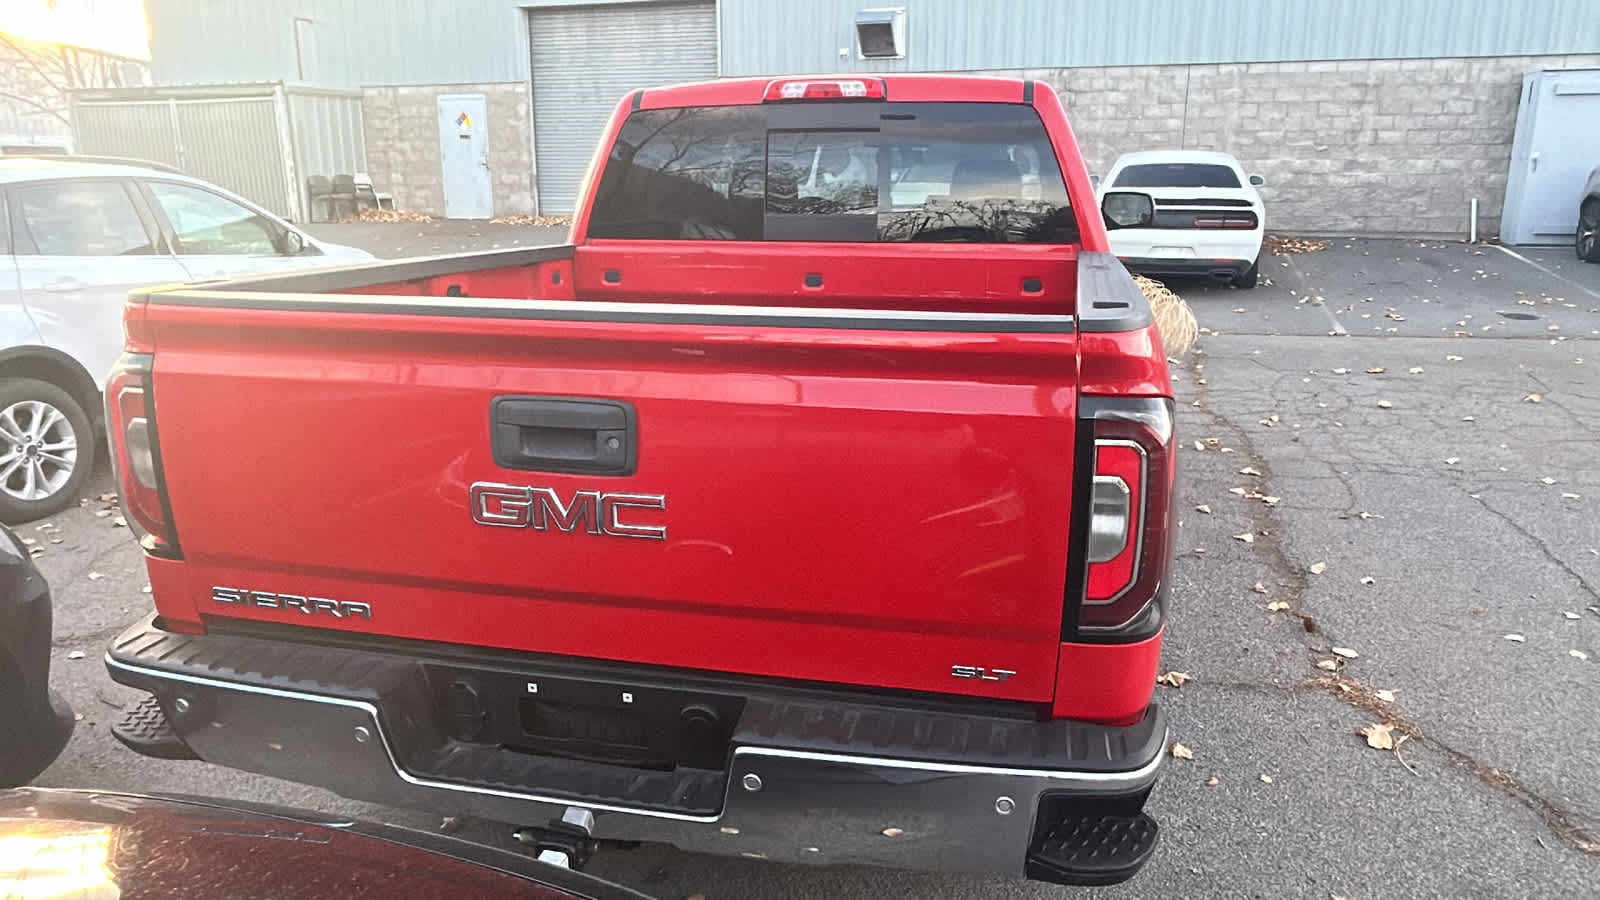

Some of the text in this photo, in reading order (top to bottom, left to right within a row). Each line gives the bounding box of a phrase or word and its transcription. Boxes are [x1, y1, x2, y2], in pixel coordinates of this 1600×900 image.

[470, 481, 667, 540] GMC
[212, 586, 371, 620] SIERRA
[951, 665, 1017, 682] SLT
